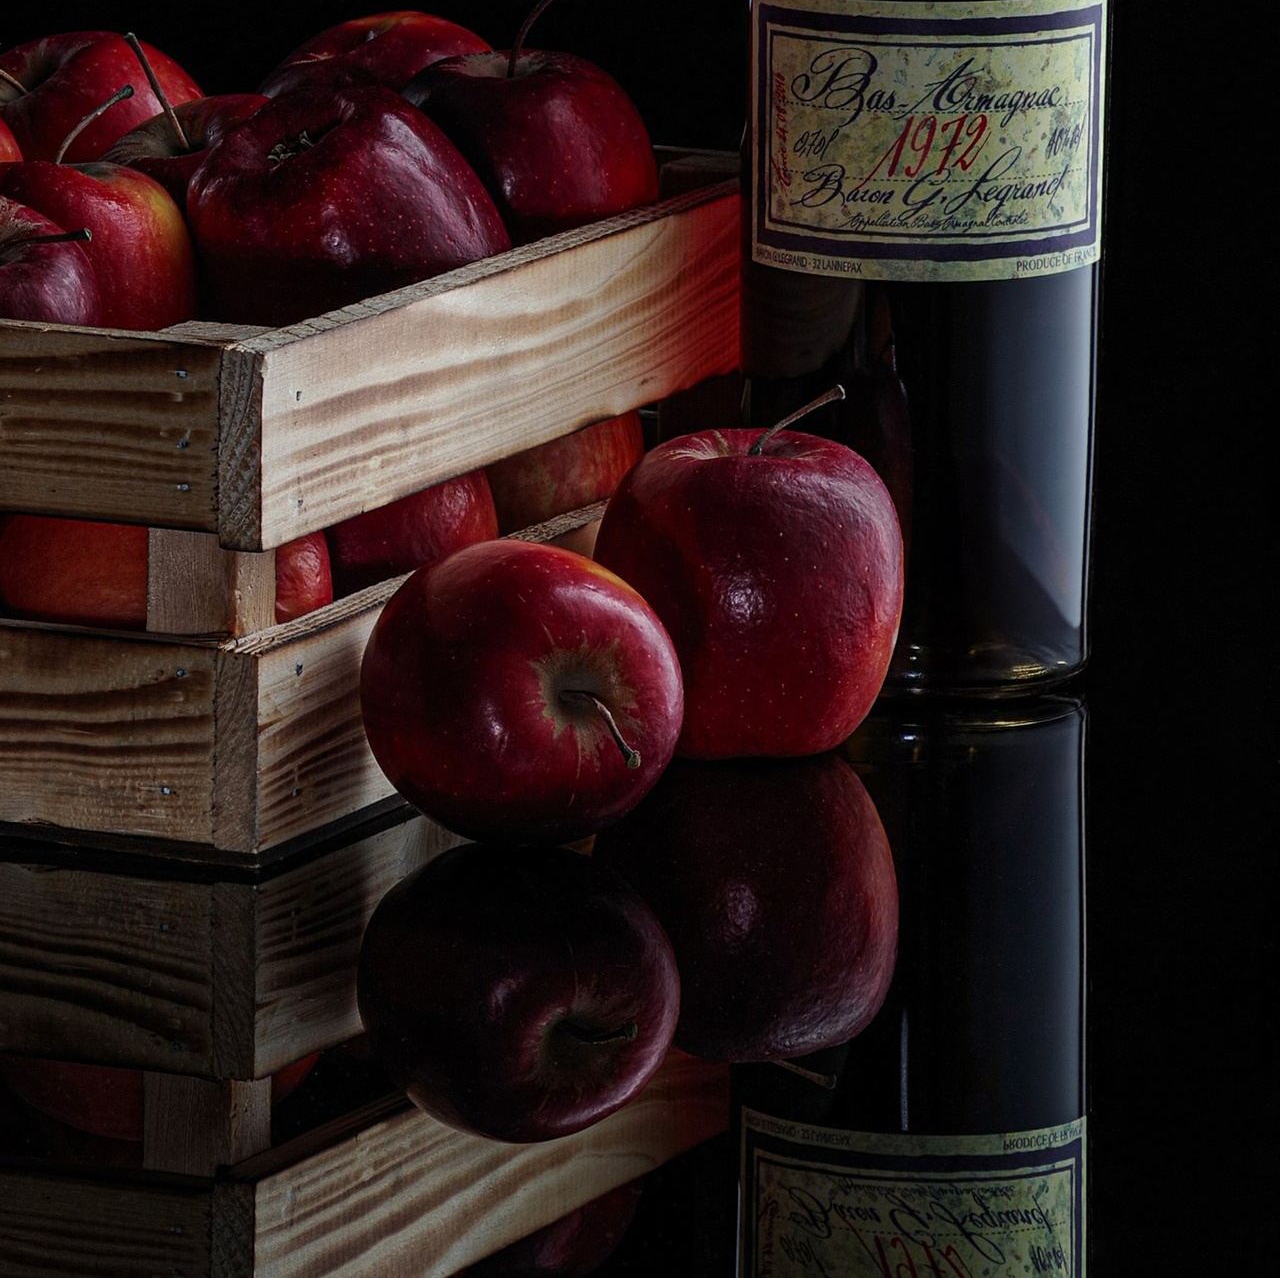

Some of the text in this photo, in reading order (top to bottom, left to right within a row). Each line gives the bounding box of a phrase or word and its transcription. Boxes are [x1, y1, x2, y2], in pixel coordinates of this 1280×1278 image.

[855, 114, 992, 189] 1972
[790, 163, 895, 208] Baron
[943, 146, 1068, 219] Legrand
[778, 252, 808, 268] LEGRAND
[812, 258, 821, 269] 32
[822, 260, 862, 274] LANNEPAX
[1016, 255, 1061, 272] PRODUCE
[1061, 252, 1074, 266] OF
